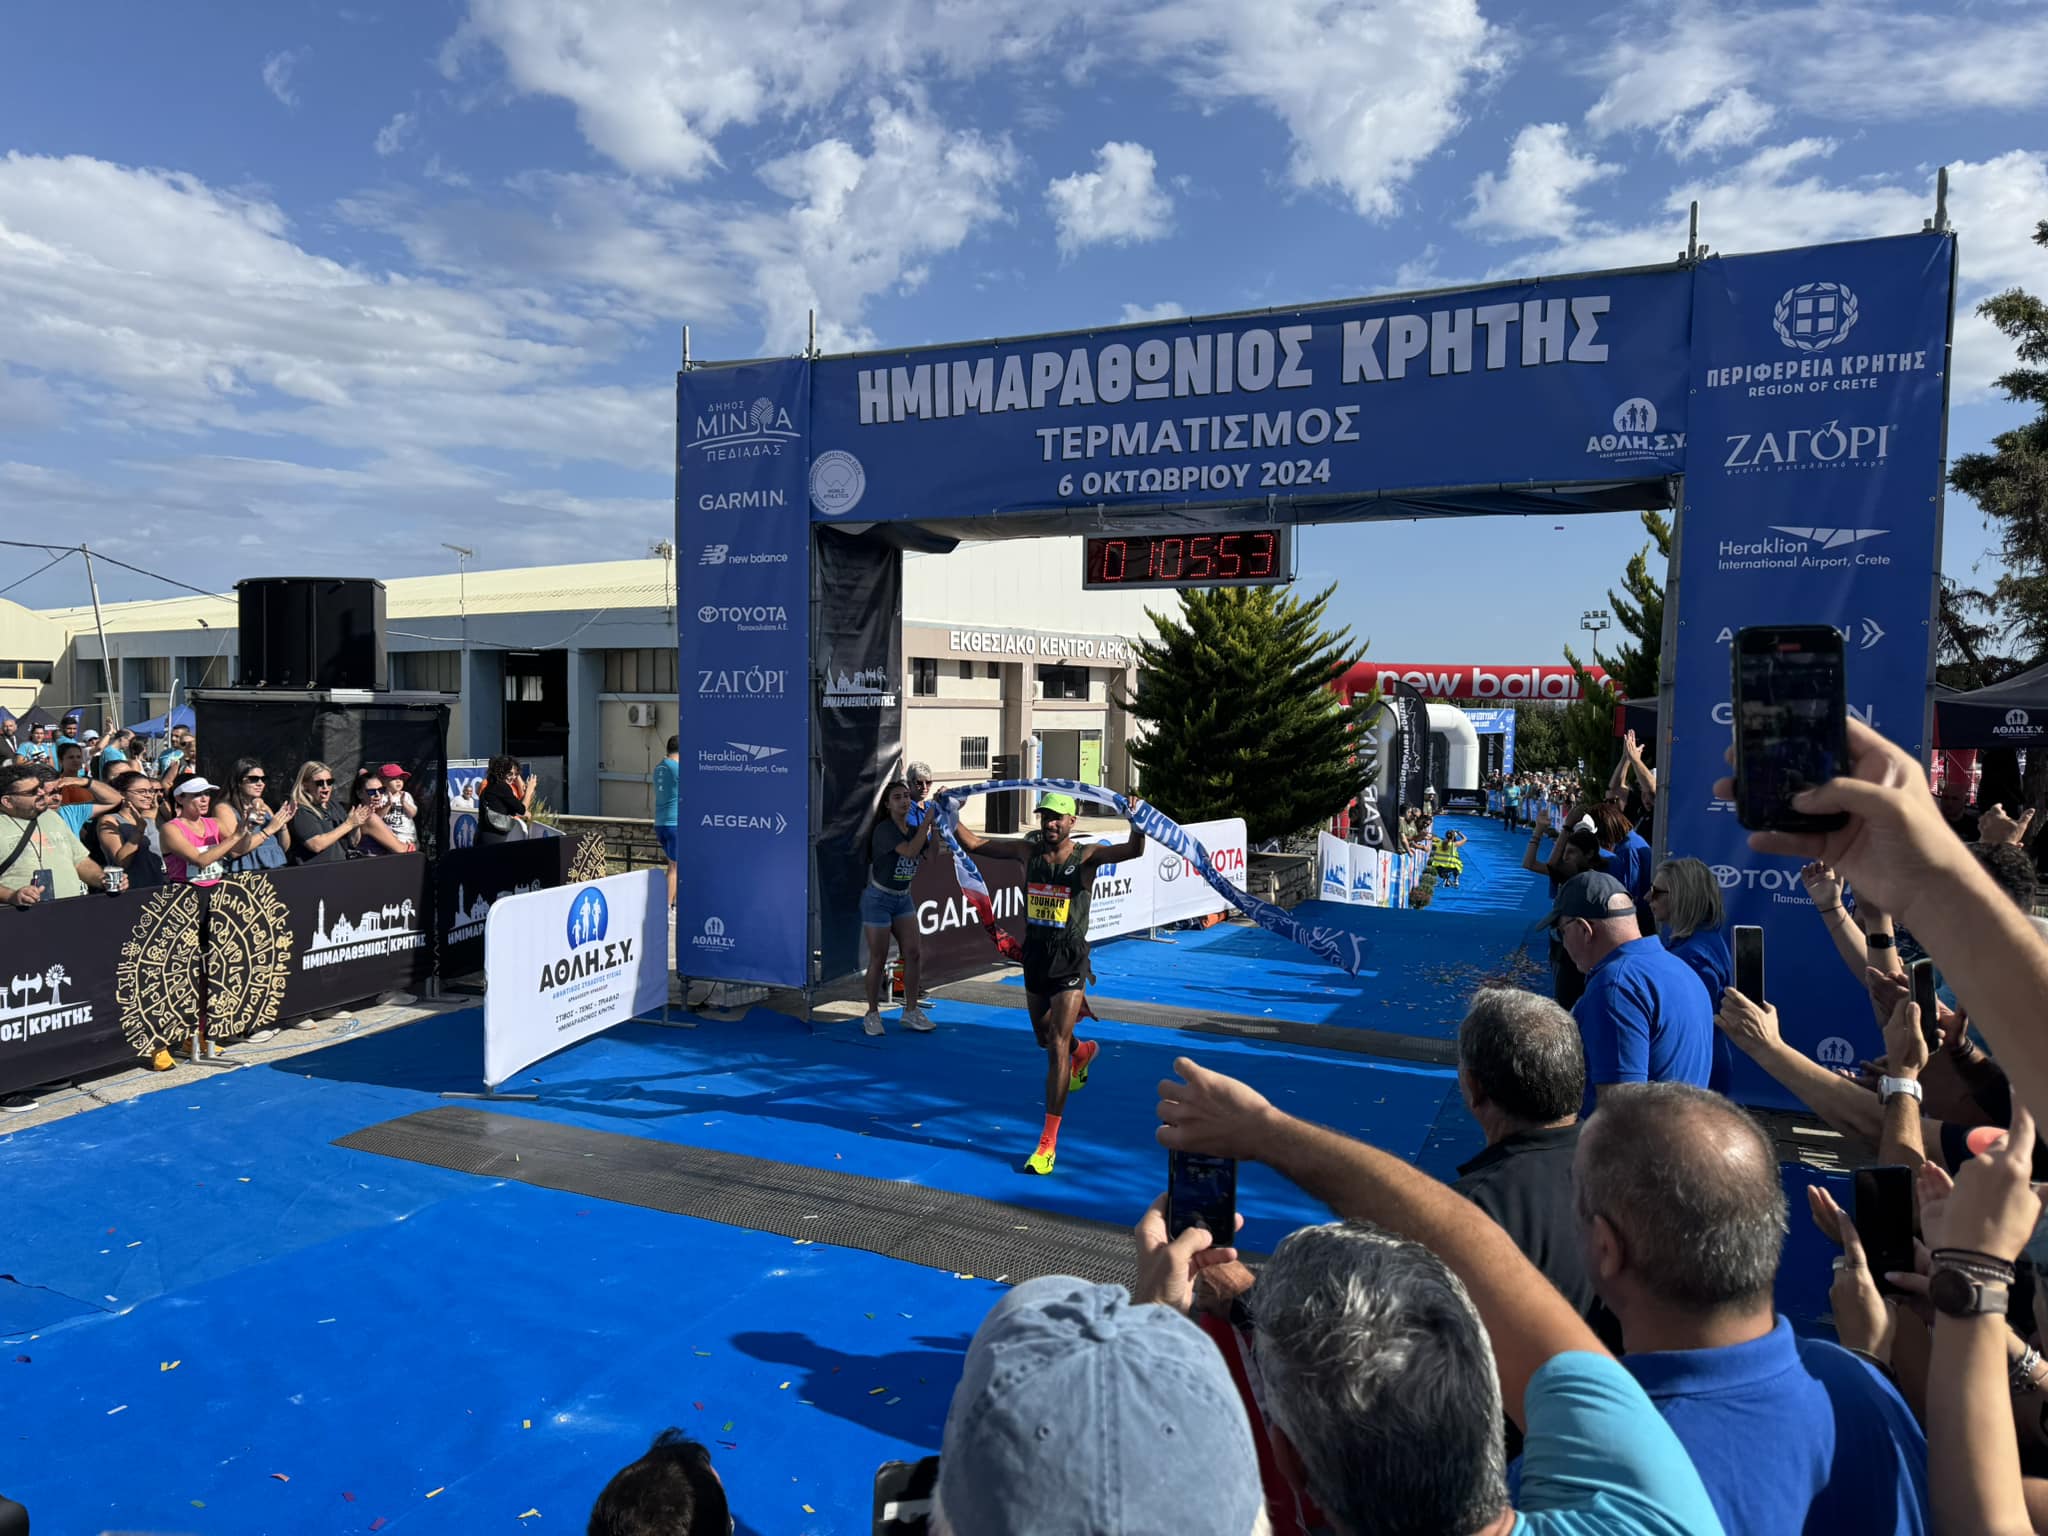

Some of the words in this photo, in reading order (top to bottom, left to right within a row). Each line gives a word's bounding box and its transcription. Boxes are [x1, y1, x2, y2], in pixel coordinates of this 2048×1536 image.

[858, 326, 1313, 424] ΗΜΙΜΑΡΑΘΩΝΙΟΣ
[1341, 296, 1611, 384] ΚΡΗΤΗΣ
[1707, 358, 1834, 387] ΠΕΡΙΦΕΡΕΙΑ
[1841, 351, 1927, 375] ΚΡΗΤΗΣ
[1749, 383, 1804, 397] REGION
[1809, 380, 1828, 392] OF
[1833, 377, 1878, 391] CRETE
[708, 401, 745, 412] ΔΗΜΟΣ
[1036, 405, 1361, 461] ΤΕΡΜΑΤΙΣΜΟΣ
[707, 444, 782, 462] ΠΕΔΙΑΔΑΣ
[1058, 473, 1074, 496] 6
[1082, 463, 1251, 495] ΟΚΤΩΒΡΙΟΥ
[1260, 458, 1331, 487] 2024
[699, 489, 785, 511] GARMIN
[1718, 538, 1808, 556] Heraklion
[729, 555, 749, 564] new
[750, 552, 788, 563] balance
[1718, 556, 1798, 570] International
[1801, 555, 1851, 570] Airport,
[1855, 553, 1891, 566] Crete
[719, 606, 788, 622] TOYOTA
[950, 631, 1036, 654] ΕΚΘΕΣΙΑΚΟ
[1039, 636, 1095, 657] ΚΕΝΤΡΟ
[1377, 670, 1462, 698] new
[699, 750, 748, 762] Heraklion
[699, 763, 743, 773] International
[770, 764, 788, 773] Crete
[701, 814, 772, 829] AEGEAN
[1030, 896, 1066, 908] ZOUHAIR
[302, 940, 387, 970] ΗΜΙΜΑΡΑΘΩΝΙΟΣ
[390, 934, 426, 953] ΚΡΗΤΗΣ
[28, 1005, 94, 1036] ΚΡΗΤΗΣ
